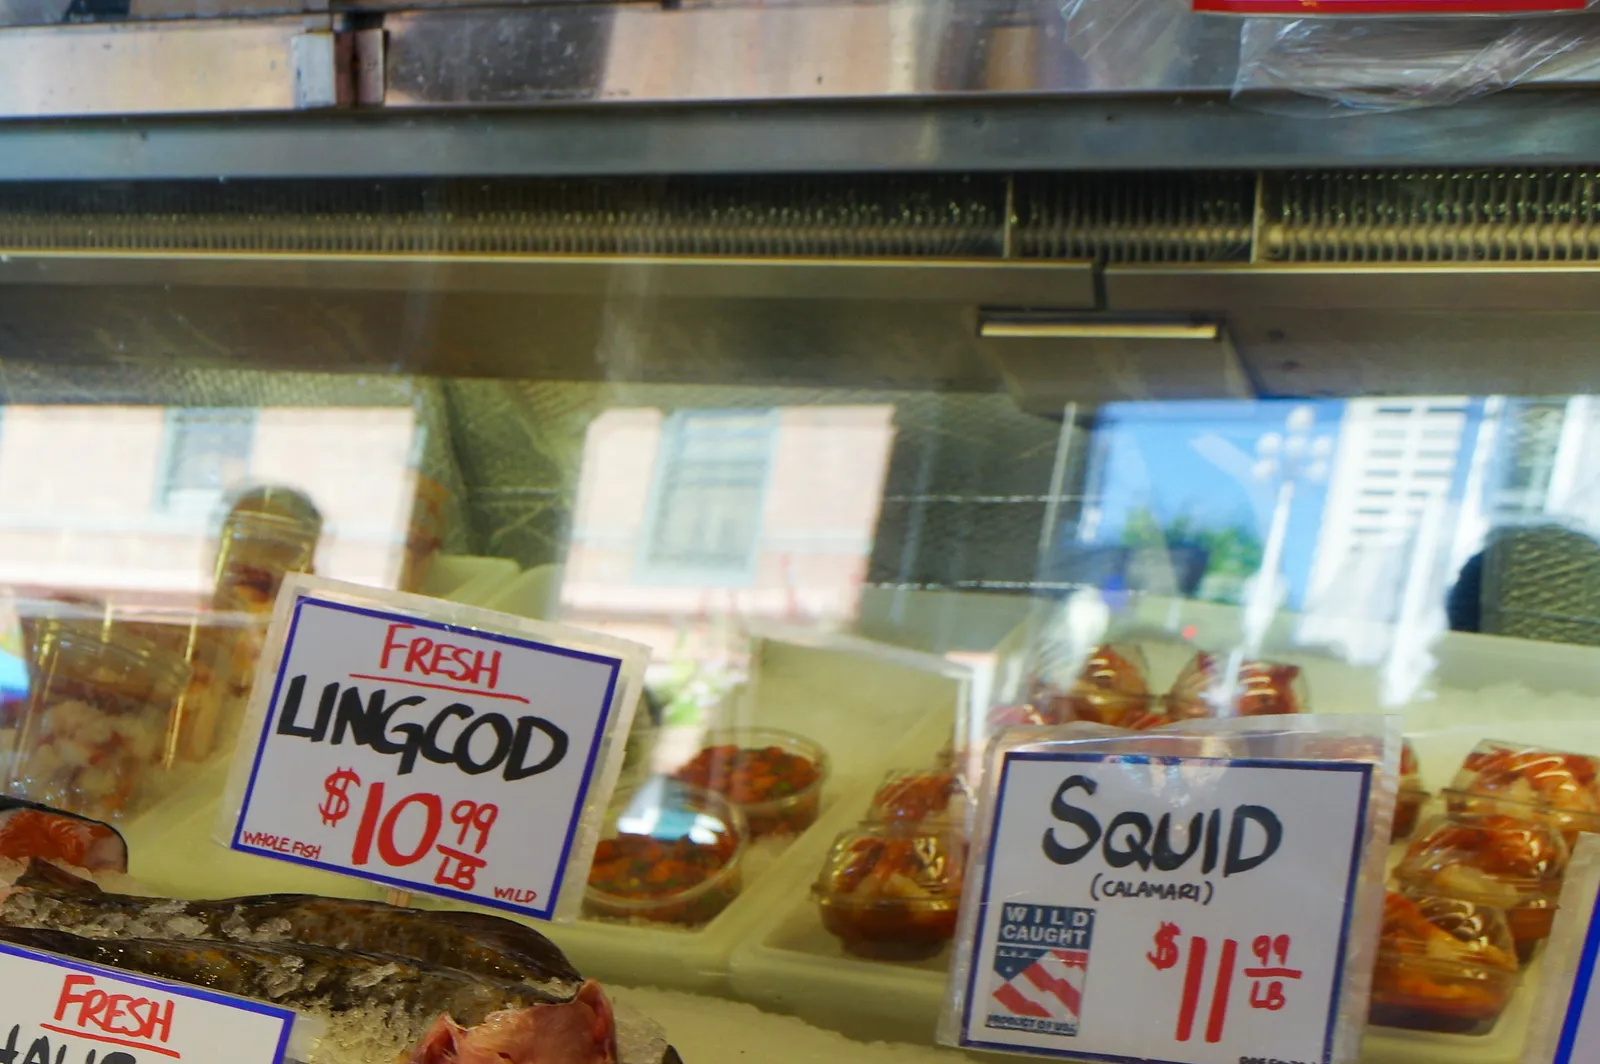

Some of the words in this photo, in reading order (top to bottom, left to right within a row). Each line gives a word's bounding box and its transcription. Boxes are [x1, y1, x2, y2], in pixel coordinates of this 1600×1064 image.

[379, 623, 502, 689] FRESH
[276, 674, 569, 782] LINGCOD
[1042, 774, 1284, 878] SQUID
[243, 830, 291, 854] WHOLE
[292, 839, 322, 861] FISH
[493, 885, 537, 904] WILD
[1090, 872, 1215, 905] (CALAMARI)
[1005, 905, 1090, 928] WILD
[1001, 923, 1087, 946] CAUGHT
[53, 974, 175, 1043] FRESH
